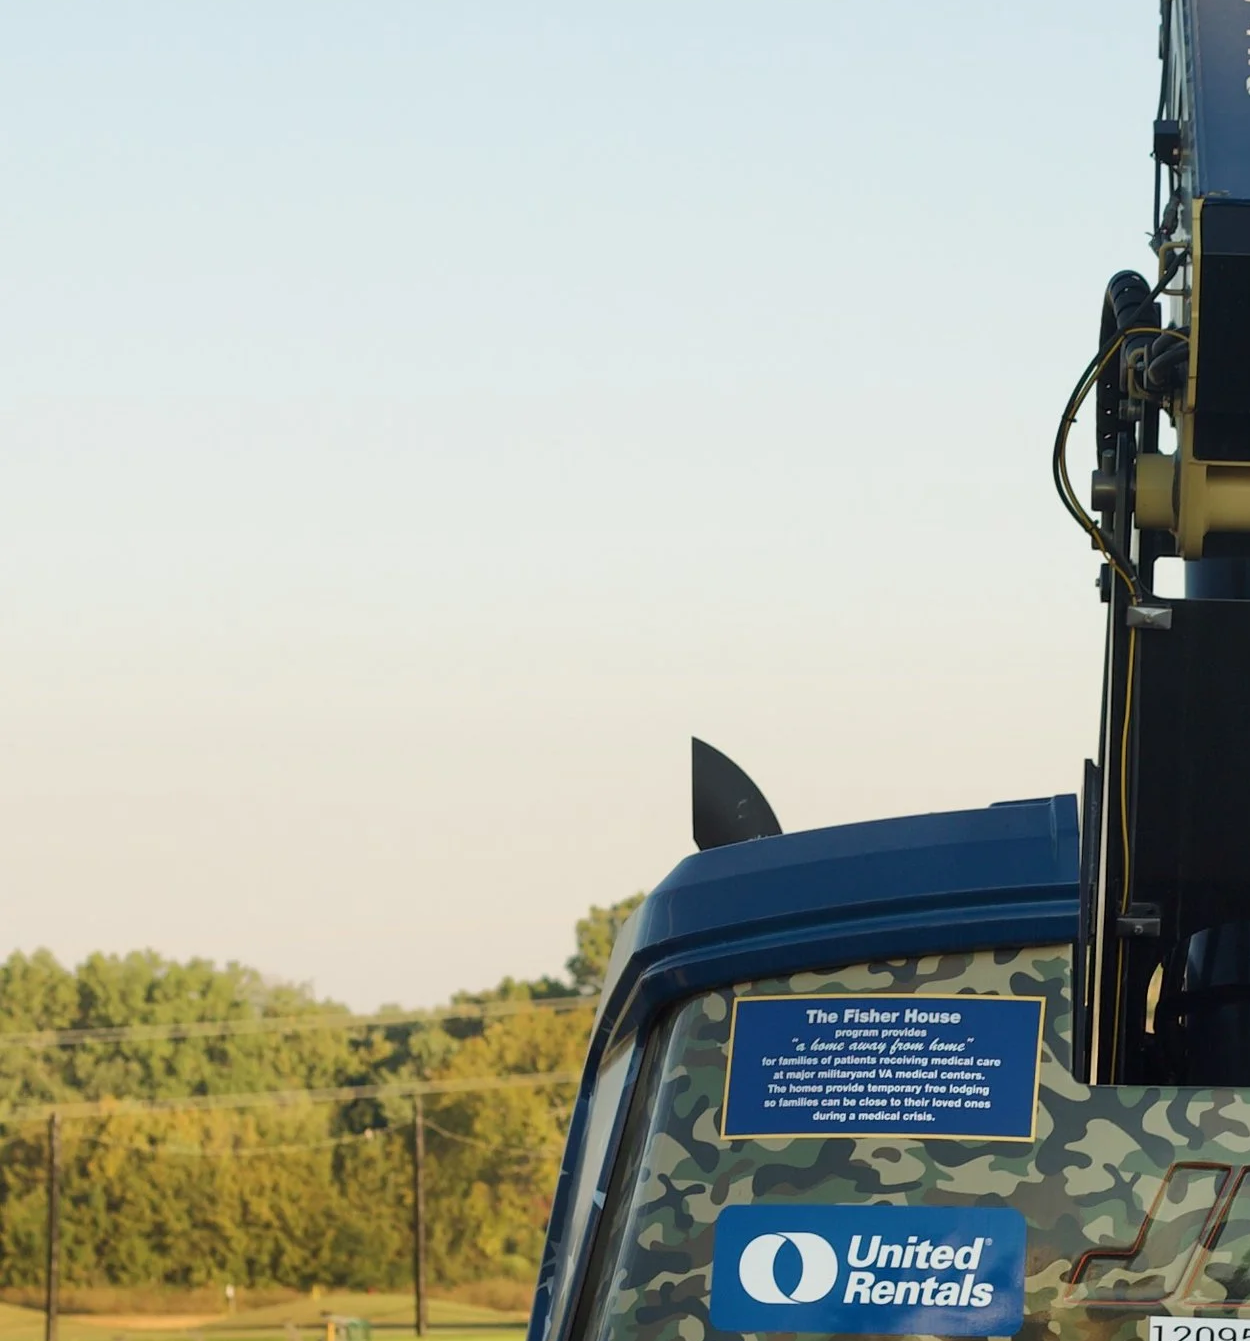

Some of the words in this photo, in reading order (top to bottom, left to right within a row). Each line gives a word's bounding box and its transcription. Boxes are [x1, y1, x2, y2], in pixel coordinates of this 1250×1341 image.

[806, 1010, 838, 1023] The
[843, 1009, 900, 1023] Fisher
[904, 1009, 961, 1023] House
[835, 1029, 878, 1039] program
[882, 1028, 927, 1038] provides
[810, 1037, 845, 1051] home
[849, 1041, 886, 1054] away
[889, 1038, 924, 1055] from
[762, 1057, 776, 1066] for
[779, 1056, 818, 1065] families
[821, 1056, 832, 1065] of
[834, 1055, 877, 1066] patients
[879, 1055, 928, 1066] receiving
[931, 1056, 974, 1065] medical
[773, 1071, 783, 1079] at
[786, 1070, 816, 1080] major
[879, 1069, 892, 1078] VA
[895, 1069, 938, 1079] medical
[940, 1071, 985, 1080] centers.
[768, 1085, 786, 1093] The
[789, 1083, 823, 1093] homes
[826, 1083, 864, 1094] provide
[868, 1083, 922, 1094] temporary
[925, 1084, 946, 1093] free
[949, 1084, 990, 1096] lodging
[779, 1098, 818, 1107] families
[843, 1097, 856, 1106] be
[859, 1097, 887, 1106] close
[890, 1098, 901, 1106] to
[904, 1098, 929, 1107] their
[932, 1098, 962, 1107] loved
[813, 1111, 846, 1122] during
[858, 1111, 900, 1121] medical
[903, 1112, 936, 1121] crisis.
[847, 1236, 985, 1270] United
[843, 1274, 994, 1308] Rentals
